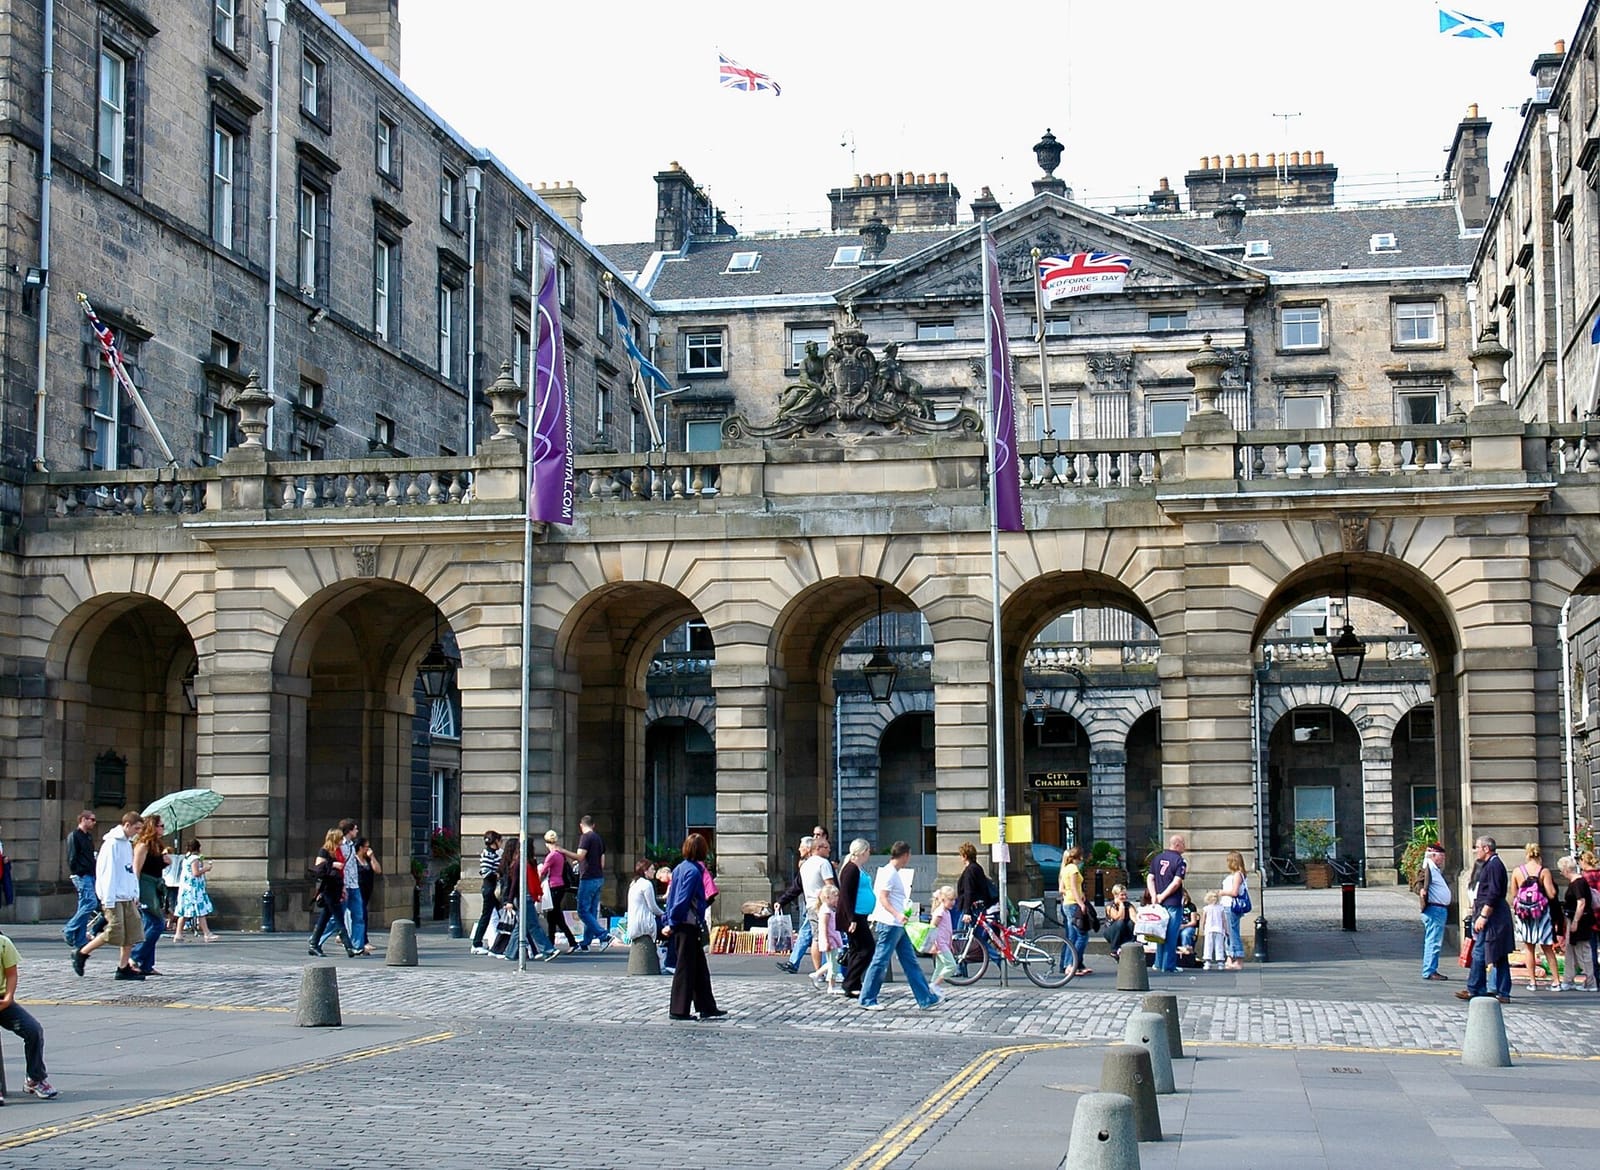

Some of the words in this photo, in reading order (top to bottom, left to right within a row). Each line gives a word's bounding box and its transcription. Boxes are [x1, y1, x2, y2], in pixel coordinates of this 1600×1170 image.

[1069, 284, 1092, 293] JUNE
[1046, 772, 1069, 780] CITY
[1034, 779, 1082, 787] CHAMBERS
[1159, 859, 1170, 876] 7
